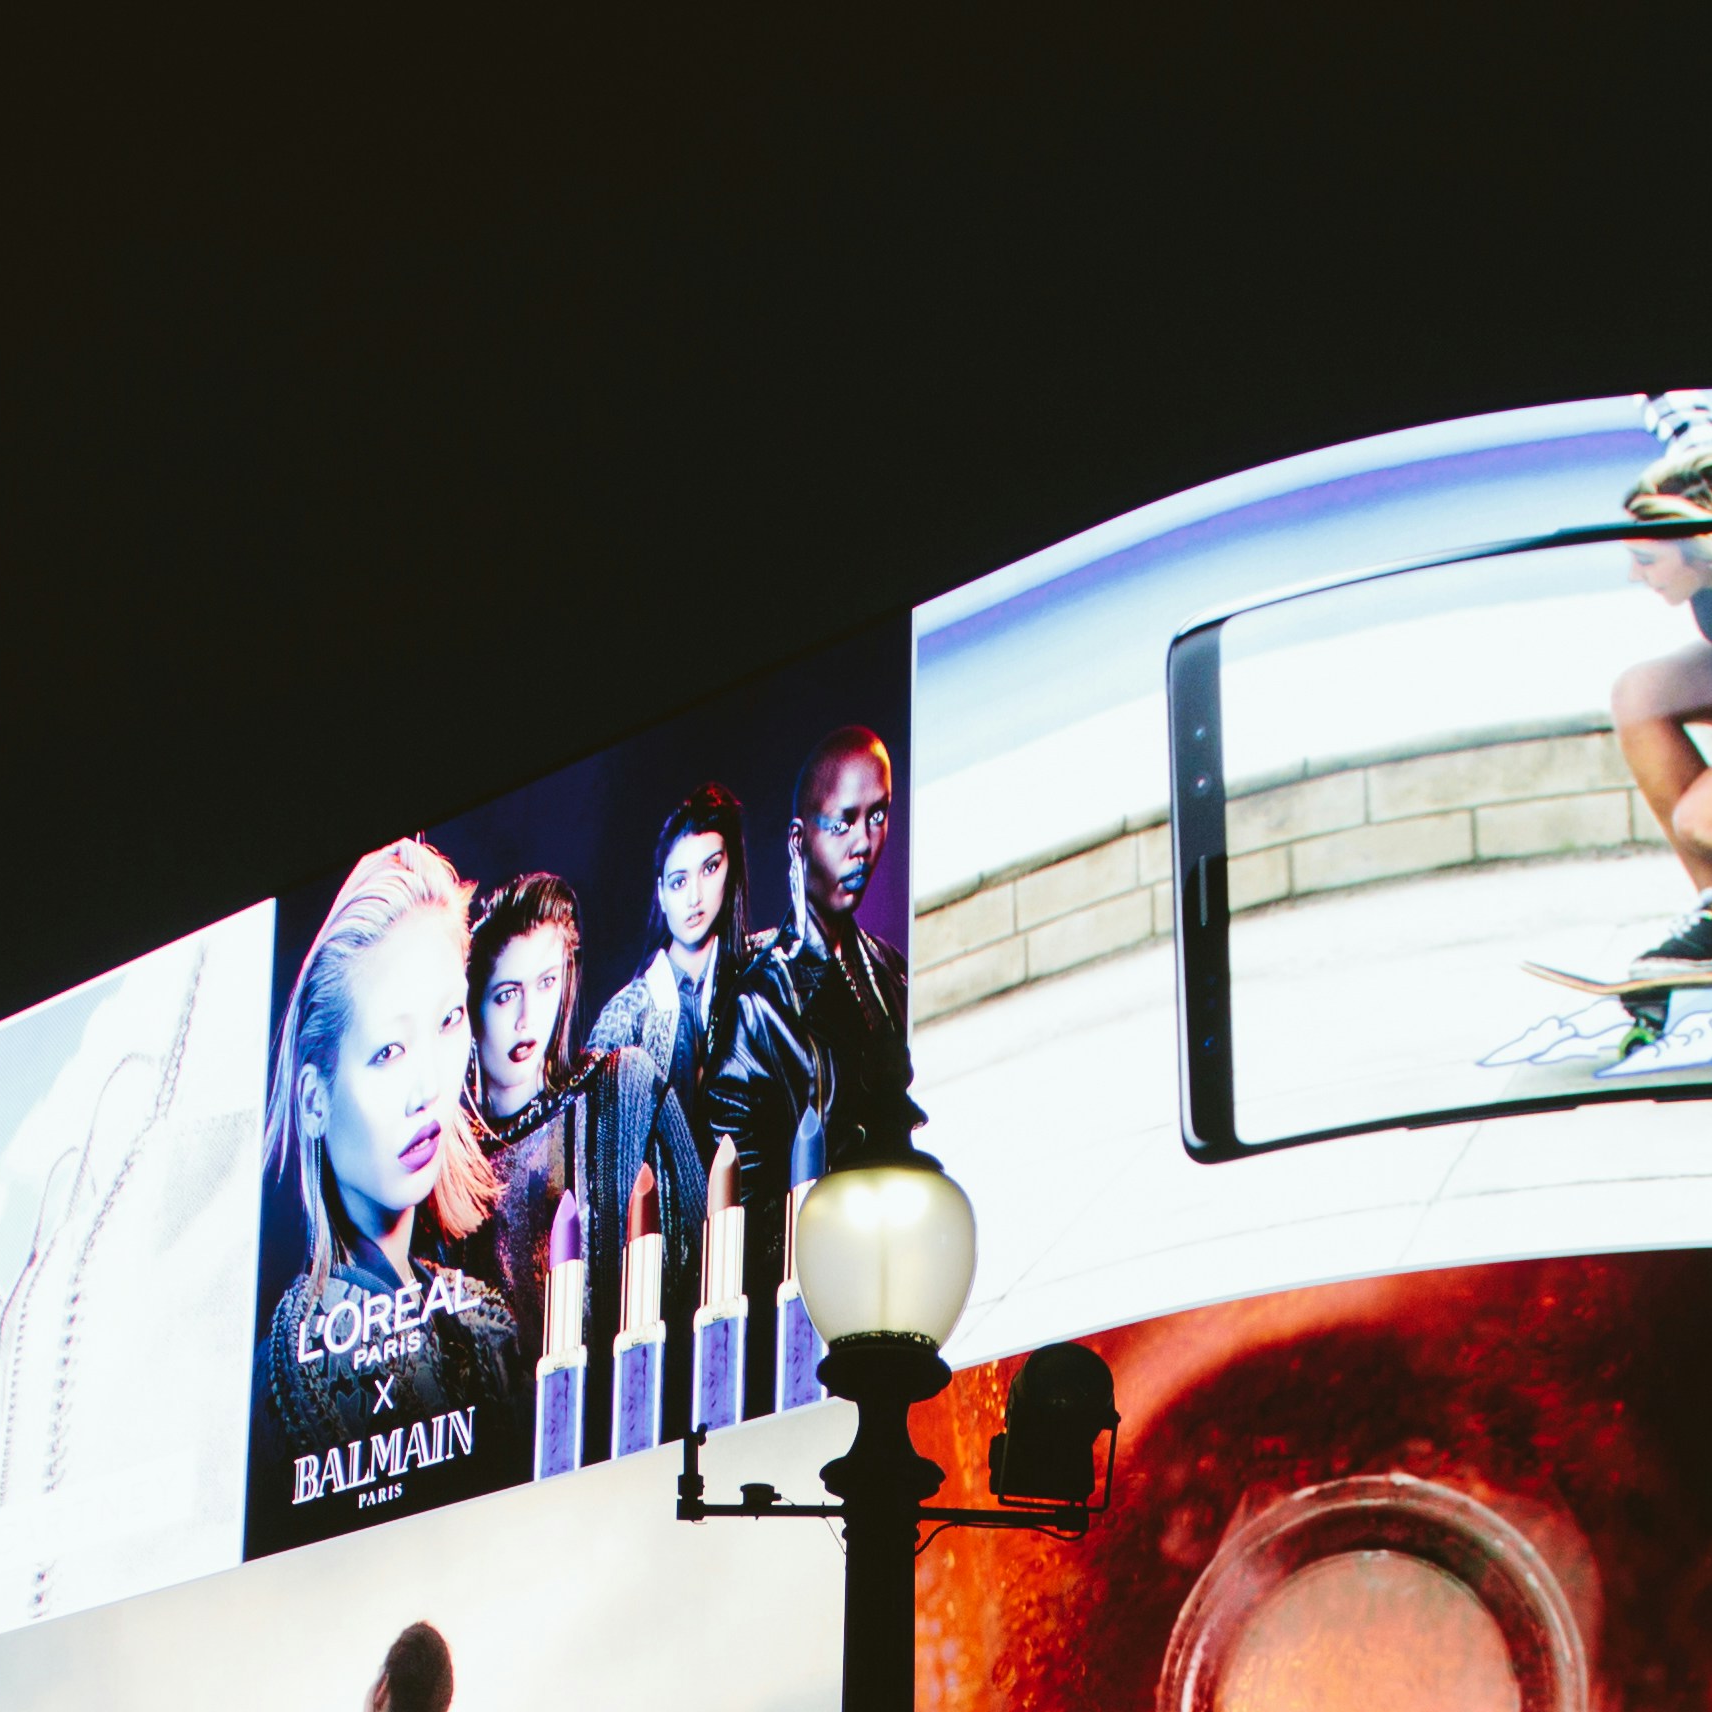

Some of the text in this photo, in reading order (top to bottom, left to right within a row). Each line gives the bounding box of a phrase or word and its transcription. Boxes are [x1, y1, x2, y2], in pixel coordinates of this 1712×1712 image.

[297, 1269, 482, 1364] L'ORÉAL
[353, 1330, 422, 1371] PARIS
[291, 1405, 476, 1506] BALMAIN
[357, 1482, 404, 1510] PARIS
